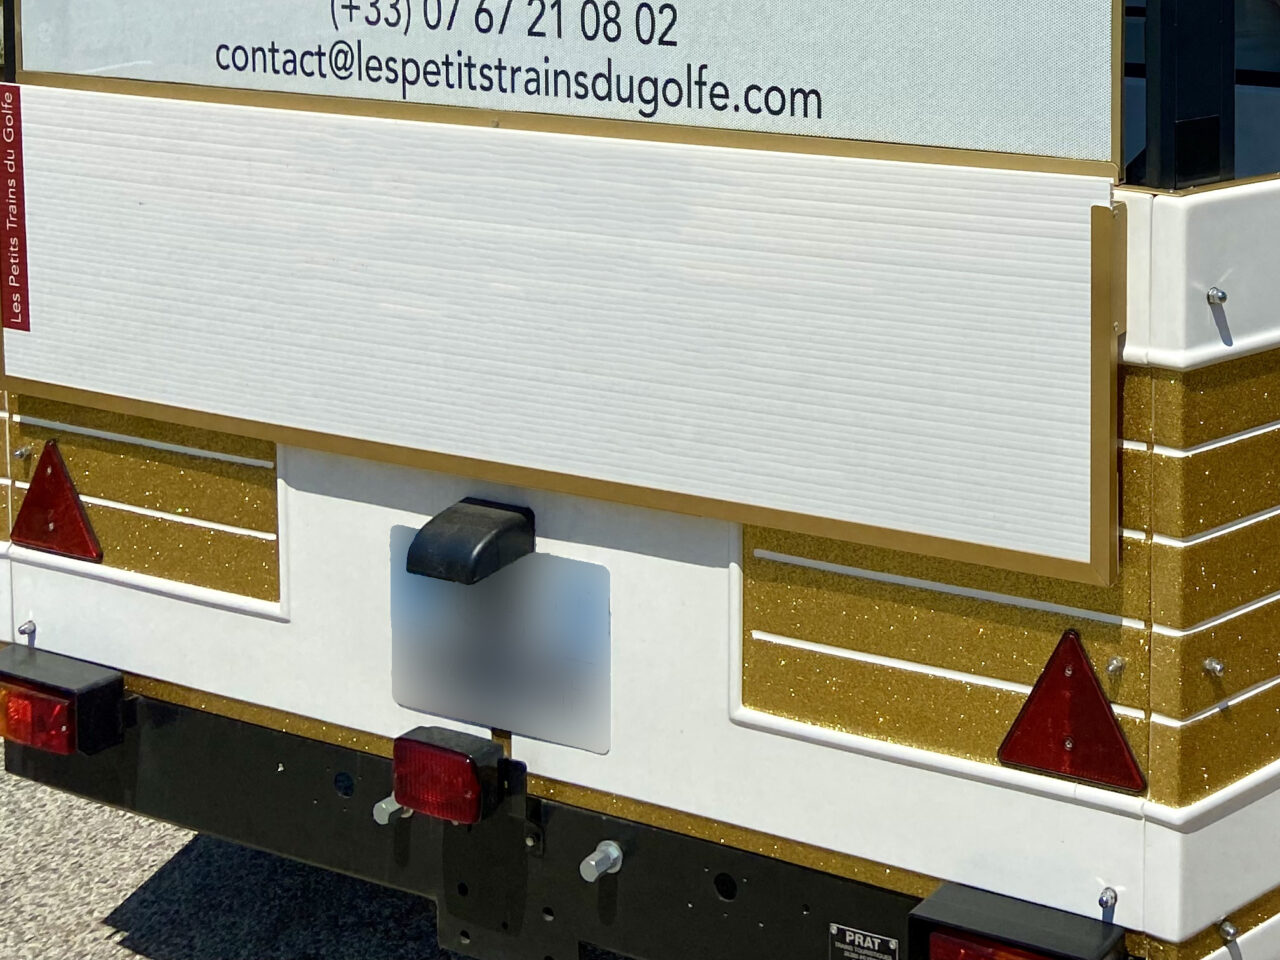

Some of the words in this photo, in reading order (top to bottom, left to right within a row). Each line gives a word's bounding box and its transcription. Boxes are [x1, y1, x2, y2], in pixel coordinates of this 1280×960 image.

[635, 1, 678, 47] 02
[215, 39, 823, 120] contact@lespetitstrainsdugolfe.com
[2, 91, 14, 143] Golfe
[4, 149, 16, 173] du
[6, 178, 17, 231] Trains
[8, 236, 20, 288] Petits
[11, 292, 22, 324] Les
[845, 930, 882, 951] PRAT
